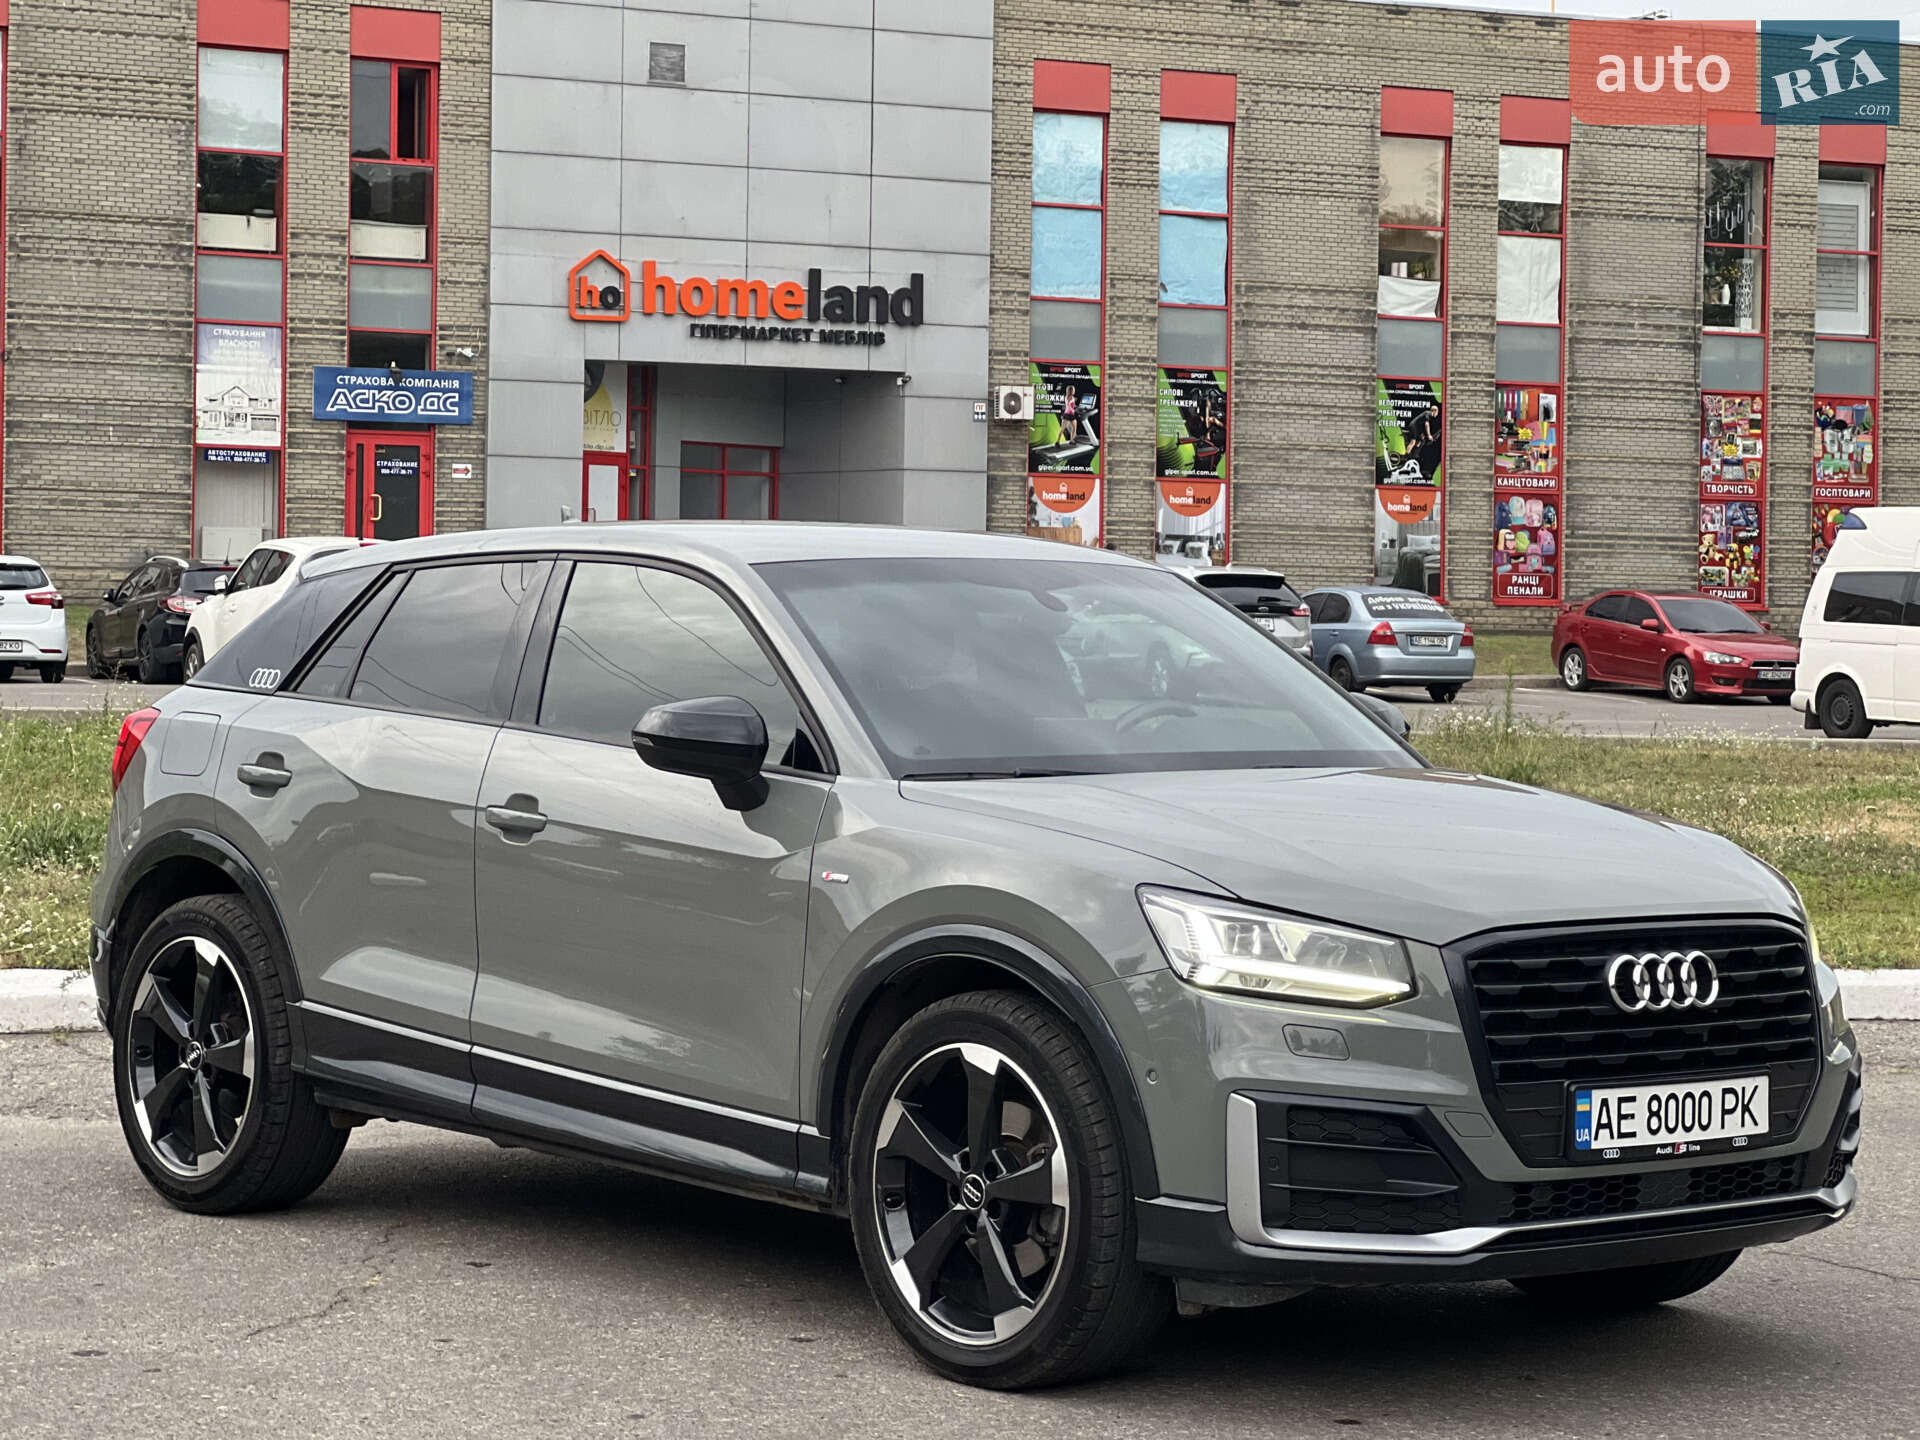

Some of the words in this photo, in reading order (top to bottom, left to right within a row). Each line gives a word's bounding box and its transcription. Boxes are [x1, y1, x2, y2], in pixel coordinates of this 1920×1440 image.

[579, 275, 621, 309] ho
[643, 260, 924, 326] homeland
[690, 323, 814, 343] ГІПЕРМАРКЕТ
[819, 329, 886, 346] МЕБЛІВ
[336, 375, 395, 386] СТРАХОВА
[399, 378, 460, 389] КОМПАНІЯ
[326, 388, 415, 414] АСКО
[1160, 399, 1198, 408] ТРЕНАЖЕРИ
[1379, 399, 1431, 408] ВЕЛОТРЕНАЖЕРИ
[208, 449, 267, 458] АВТОСТРАХОВАНИЕ
[376, 460, 418, 468] СТРАХОВАНИЕ
[1497, 477, 1556, 488] КАНЦТОВАРИ
[1706, 484, 1754, 494] ТВОРЧІСТЬ
[1815, 487, 1871, 498] ГОСПТОВАРИ
[1042, 490, 1086, 501] homeland
[1169, 494, 1212, 505] homeland
[1387, 501, 1428, 512] homeland
[1512, 575, 1539, 585] РАНЦІ
[1507, 586, 1544, 595] ПЕНАЛИ
[1576, 1129, 1590, 1143] UA
[1594, 1096, 1637, 1141] AE
[1646, 1090, 1713, 1136] 8000
[1720, 1085, 1759, 1130] PK
[1656, 1145, 1672, 1154] Audi
[1688, 1144, 1701, 1152] line
